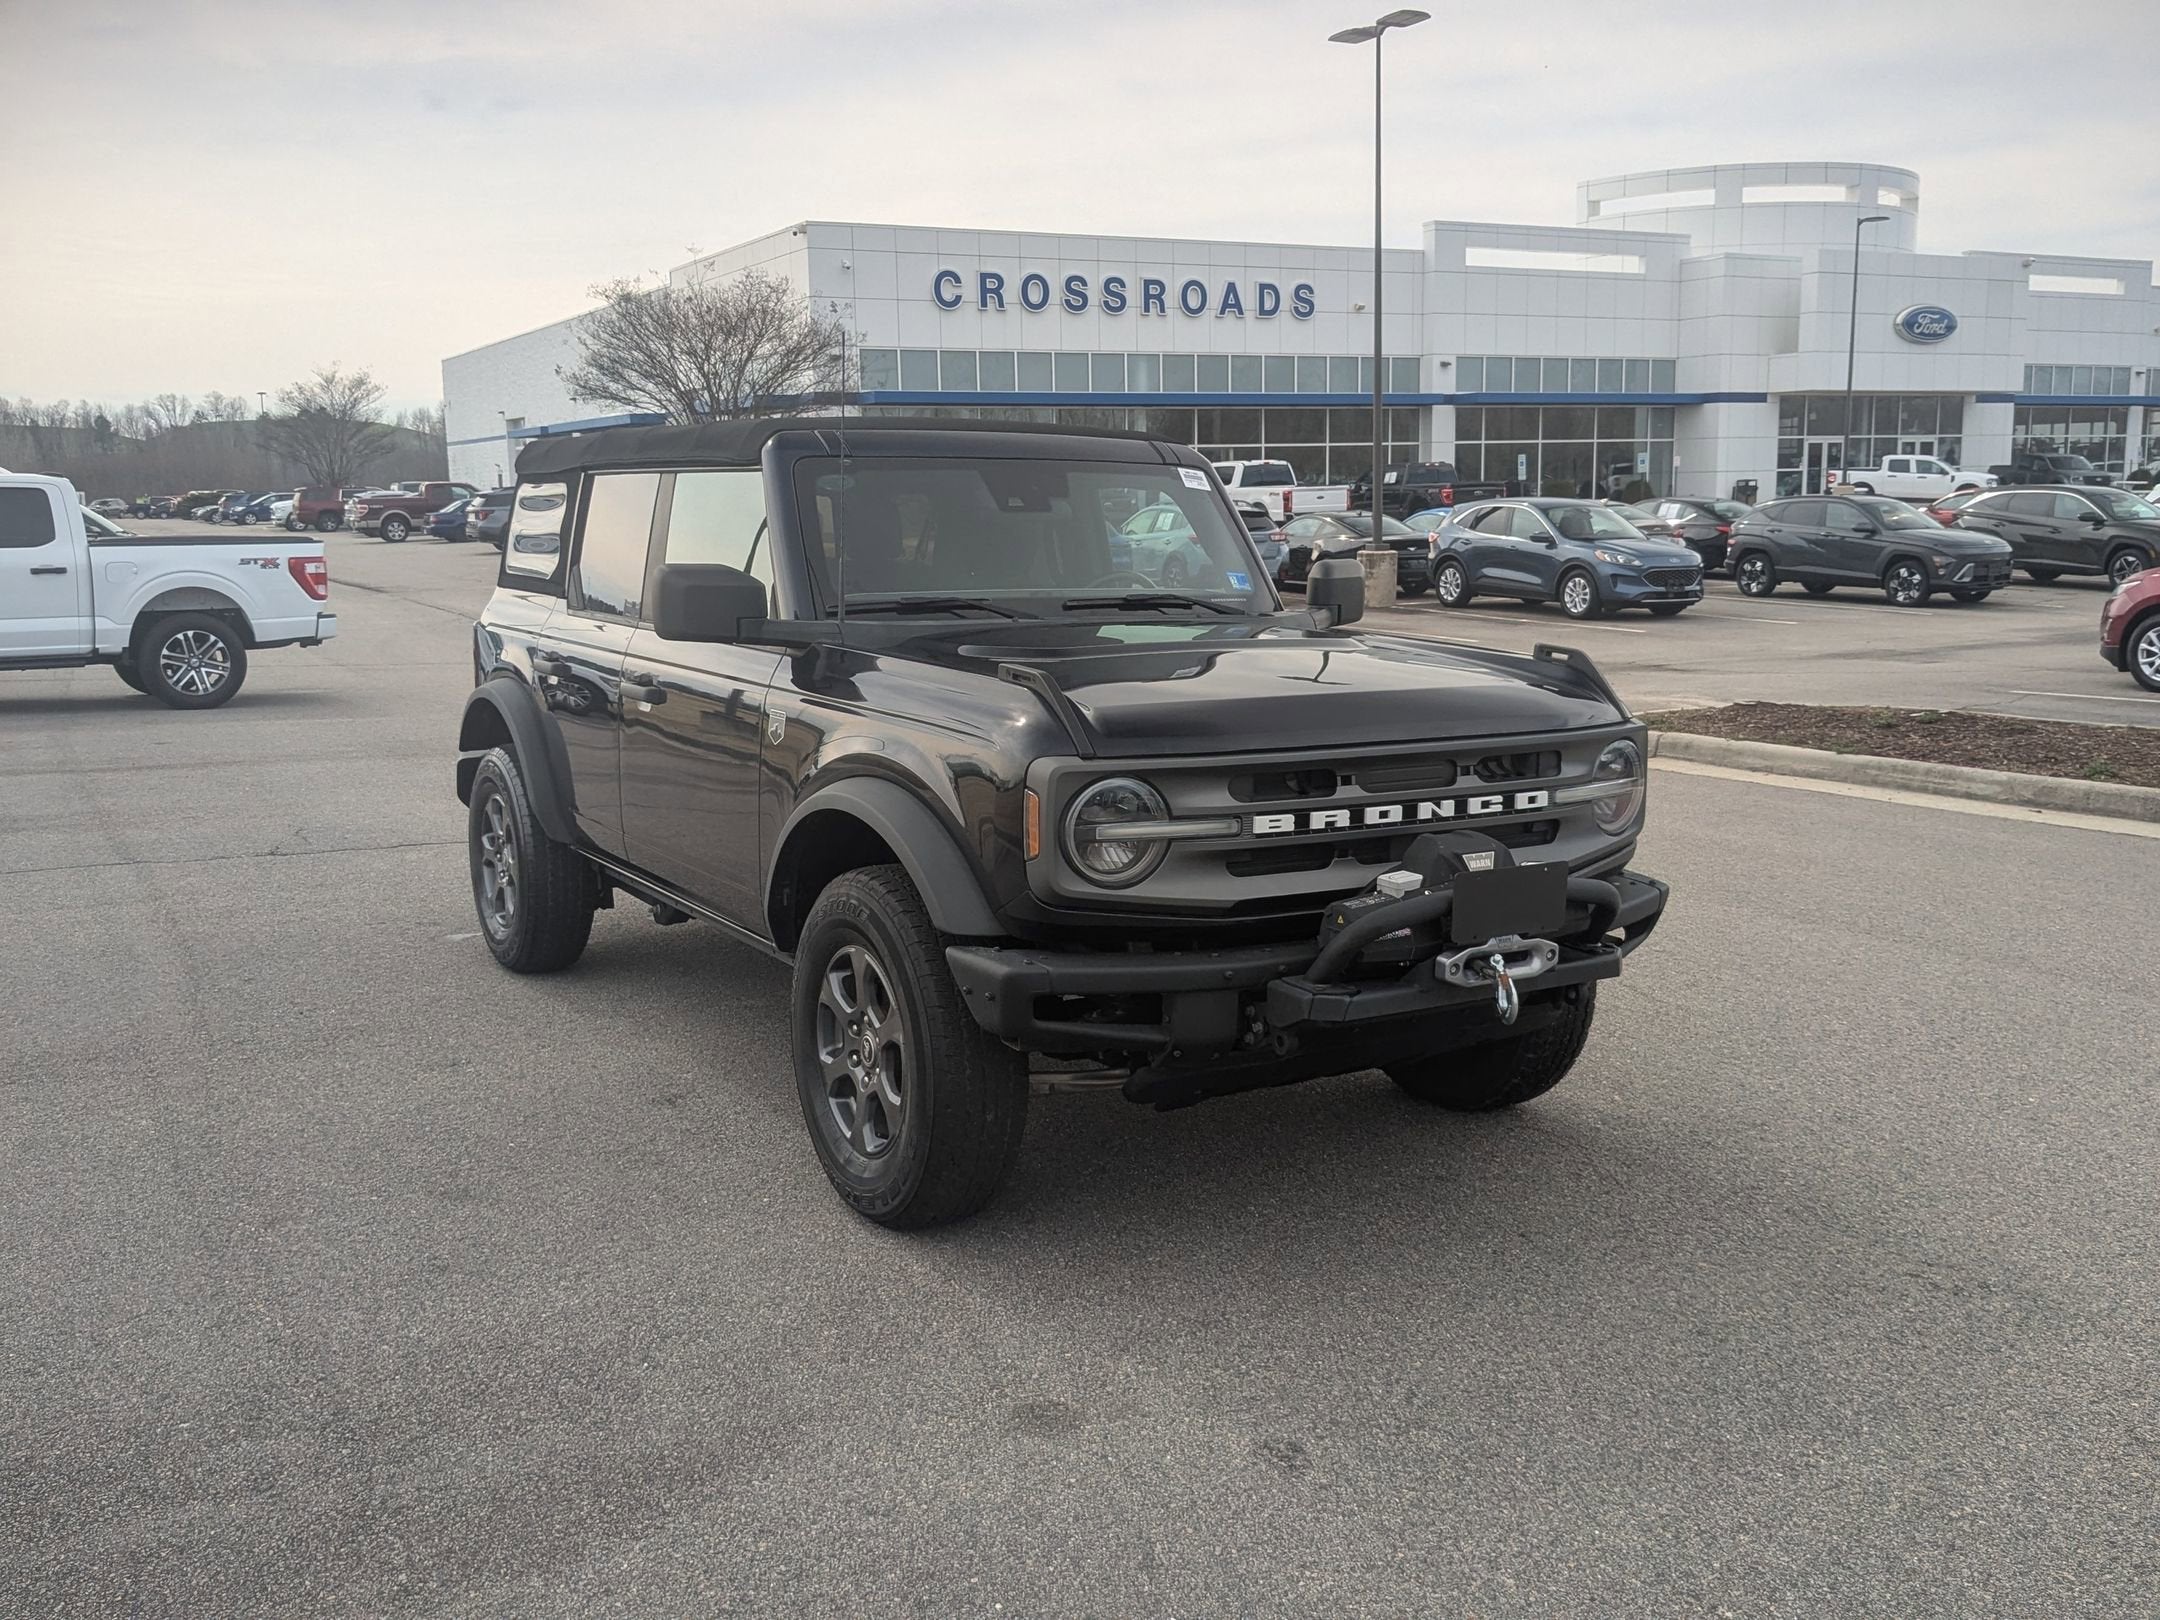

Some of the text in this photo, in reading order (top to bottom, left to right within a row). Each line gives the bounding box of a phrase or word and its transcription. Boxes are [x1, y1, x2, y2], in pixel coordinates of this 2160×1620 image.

[932, 269, 1315, 320] CROSSROADS
[1914, 312, 1948, 333] Ford
[239, 557, 280, 567] STX
[1252, 790, 1548, 833] BRONCO
[1468, 858, 1491, 868] WARN
